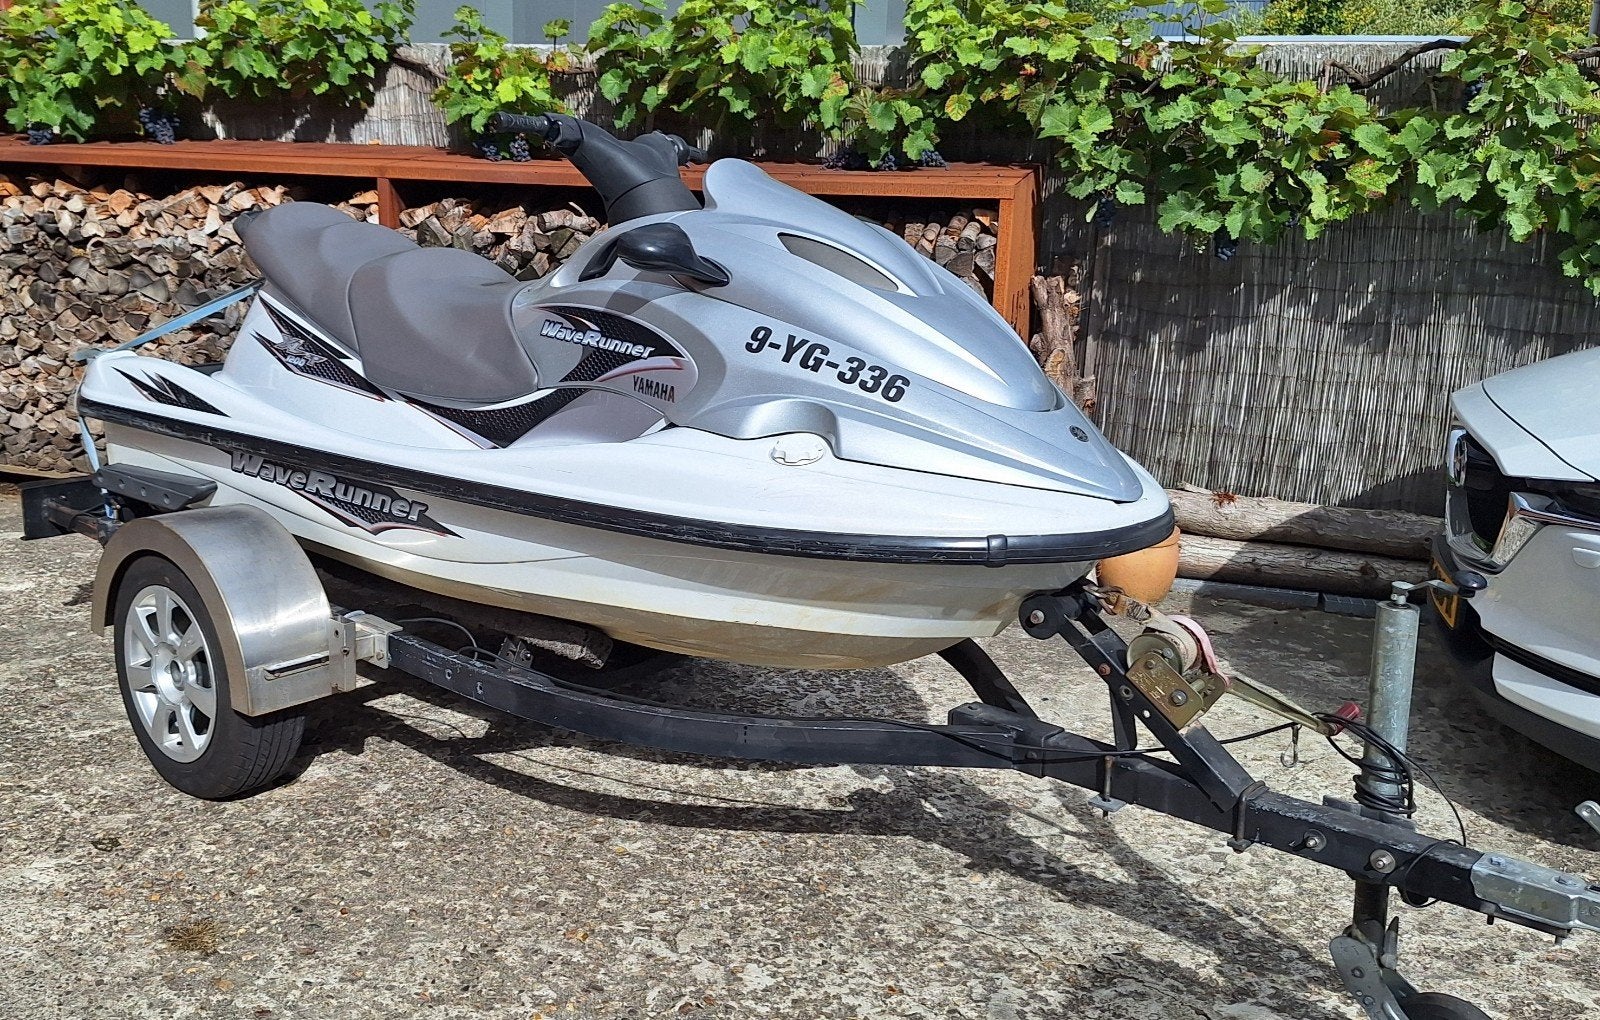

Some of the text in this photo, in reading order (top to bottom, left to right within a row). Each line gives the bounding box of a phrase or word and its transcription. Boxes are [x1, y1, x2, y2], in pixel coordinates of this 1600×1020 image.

[540, 320, 656, 360] WaveRunner
[745, 326, 911, 403] 9-YG-336
[633, 375, 676, 403] YAMAHA
[231, 451, 430, 523] WaveRunner
